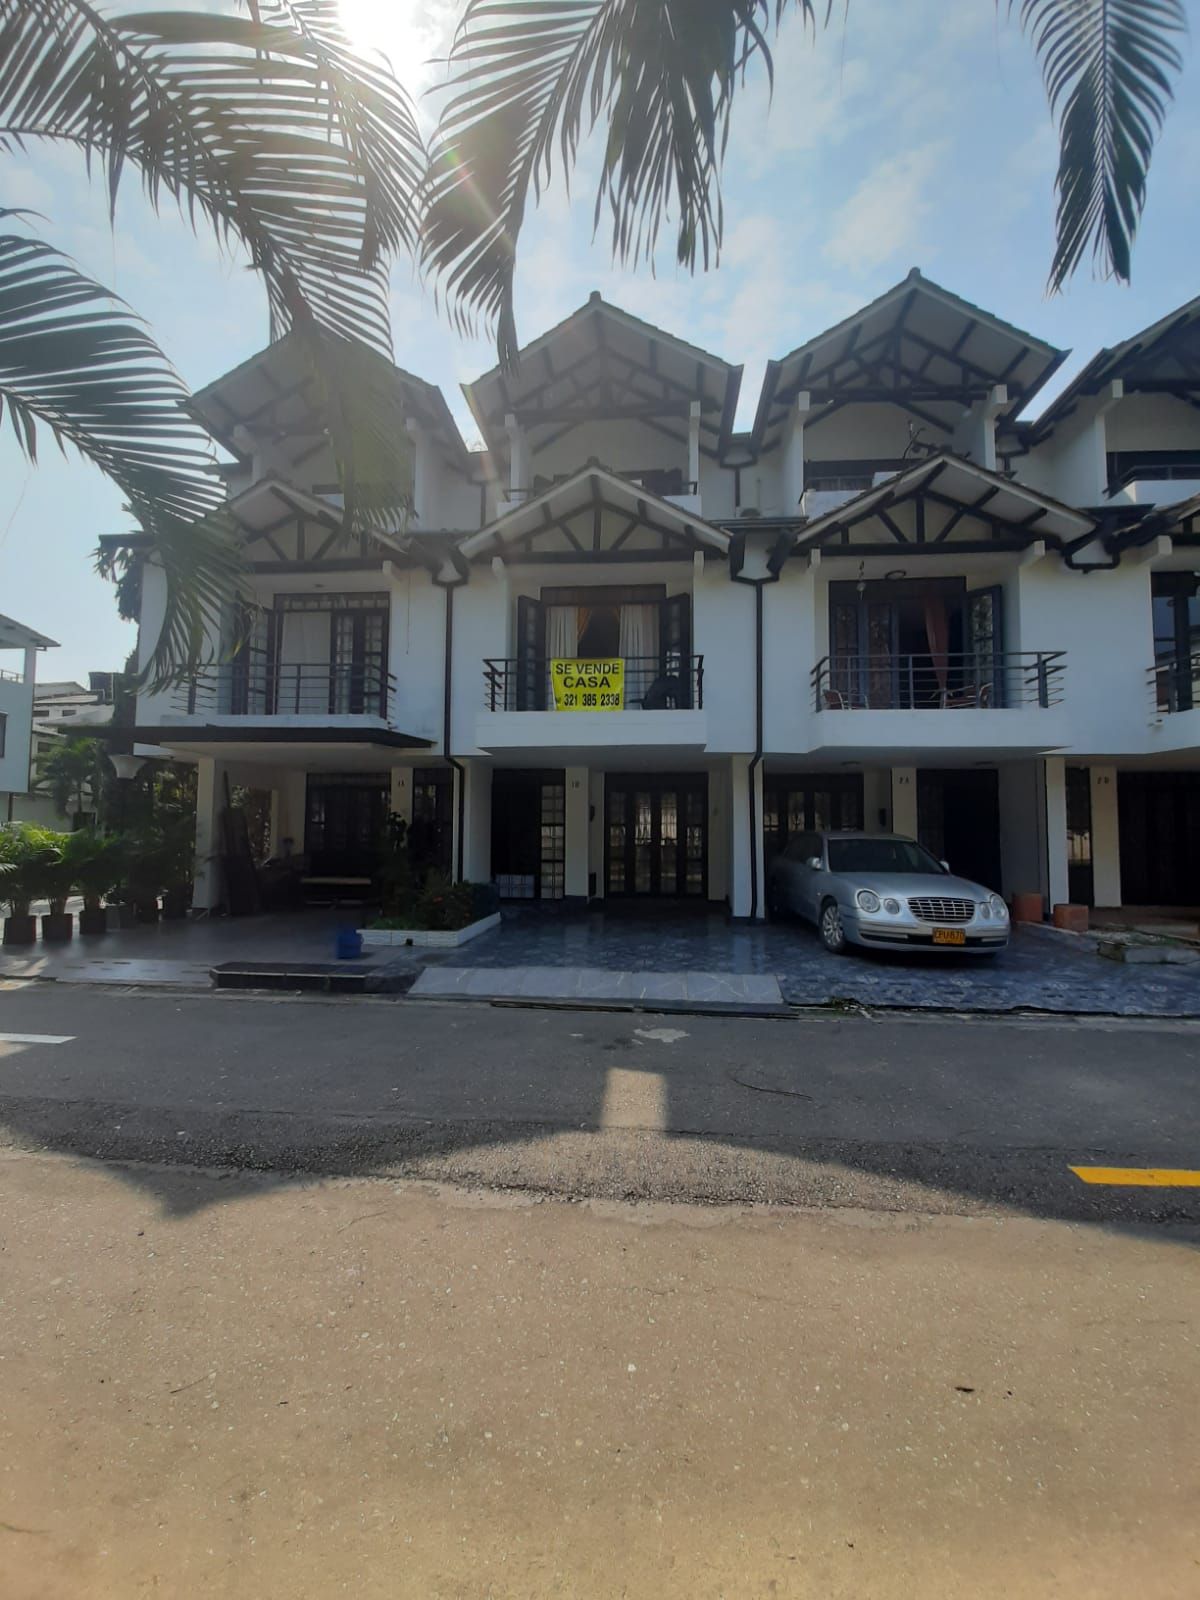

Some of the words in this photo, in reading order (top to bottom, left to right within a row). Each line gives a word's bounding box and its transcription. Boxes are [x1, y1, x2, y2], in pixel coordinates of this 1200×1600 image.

[555, 663, 572, 675] SE
[576, 663, 620, 675] VENDE
[563, 676, 611, 688] CASA
[564, 693, 578, 706] 321
[582, 693, 597, 706] 385
